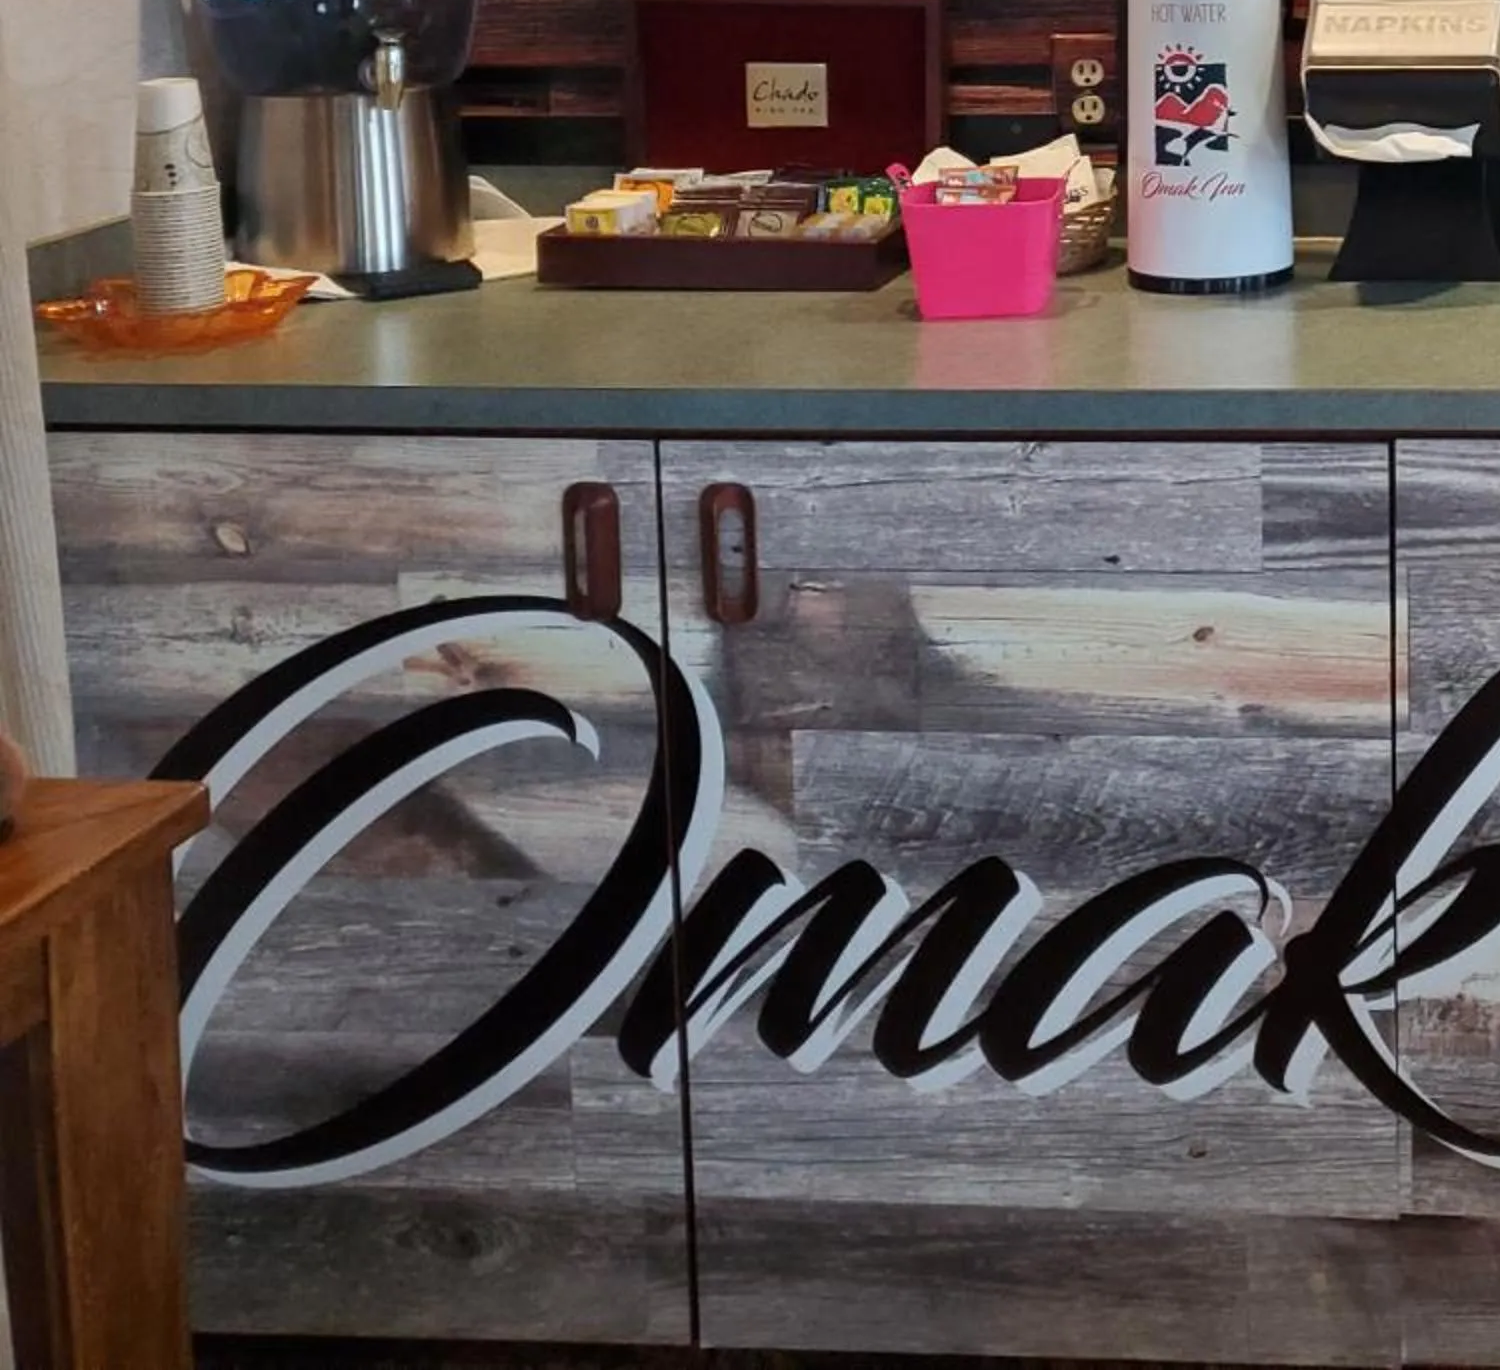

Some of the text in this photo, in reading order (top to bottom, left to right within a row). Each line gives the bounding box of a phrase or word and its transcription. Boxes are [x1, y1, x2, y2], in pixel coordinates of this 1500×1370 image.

[1150, 2, 1227, 24] HOT WATER
[1325, 14, 1489, 35] NAPKINS
[1141, 170, 1247, 202] Omak Inn
